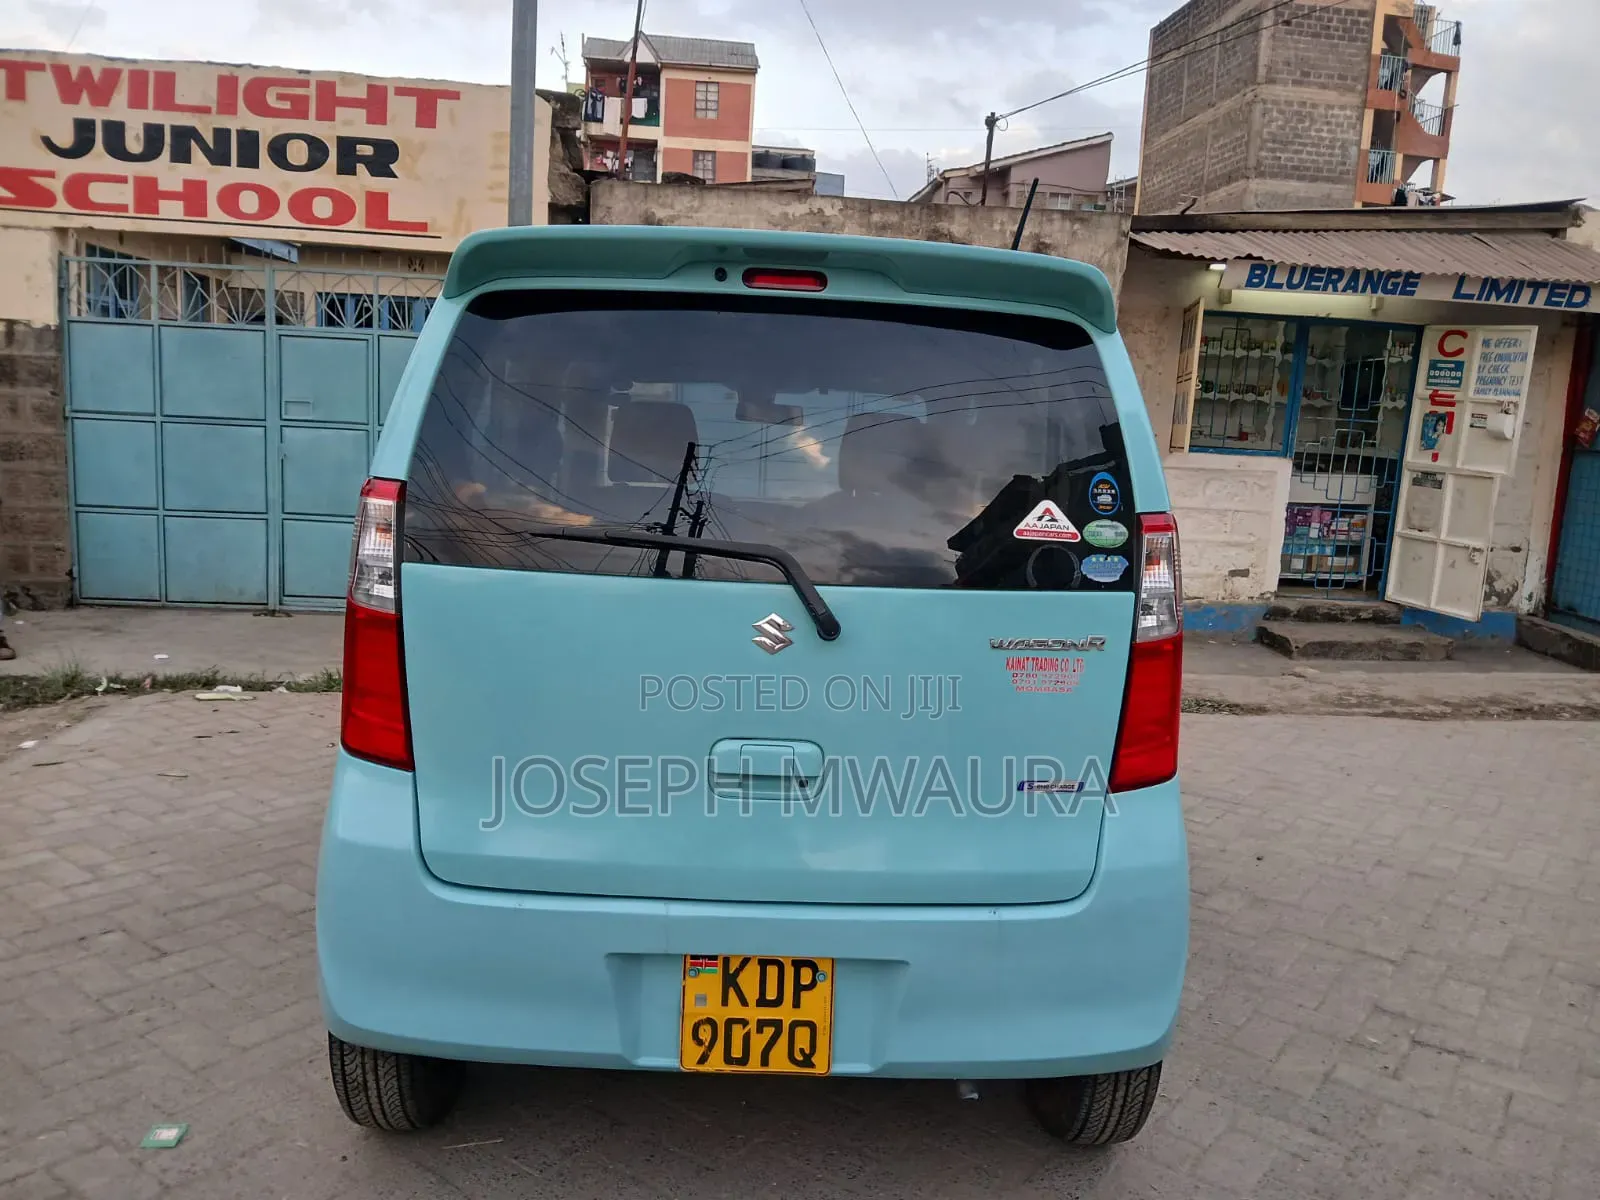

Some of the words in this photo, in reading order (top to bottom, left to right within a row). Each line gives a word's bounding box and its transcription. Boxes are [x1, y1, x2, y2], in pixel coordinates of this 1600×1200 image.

[0, 60, 461, 129] TWILIGHT
[40, 118, 400, 179] JUNIOR
[0, 167, 428, 233] SCHOOL
[1244, 263, 1422, 297] BLUERANGE
[1452, 275, 1592, 309] LIMITED
[1040, 523, 1070, 531] JAPAN
[1031, 657, 1059, 672] TRADING
[720, 956, 820, 1010] KDP
[691, 1016, 818, 1069] 907Q
